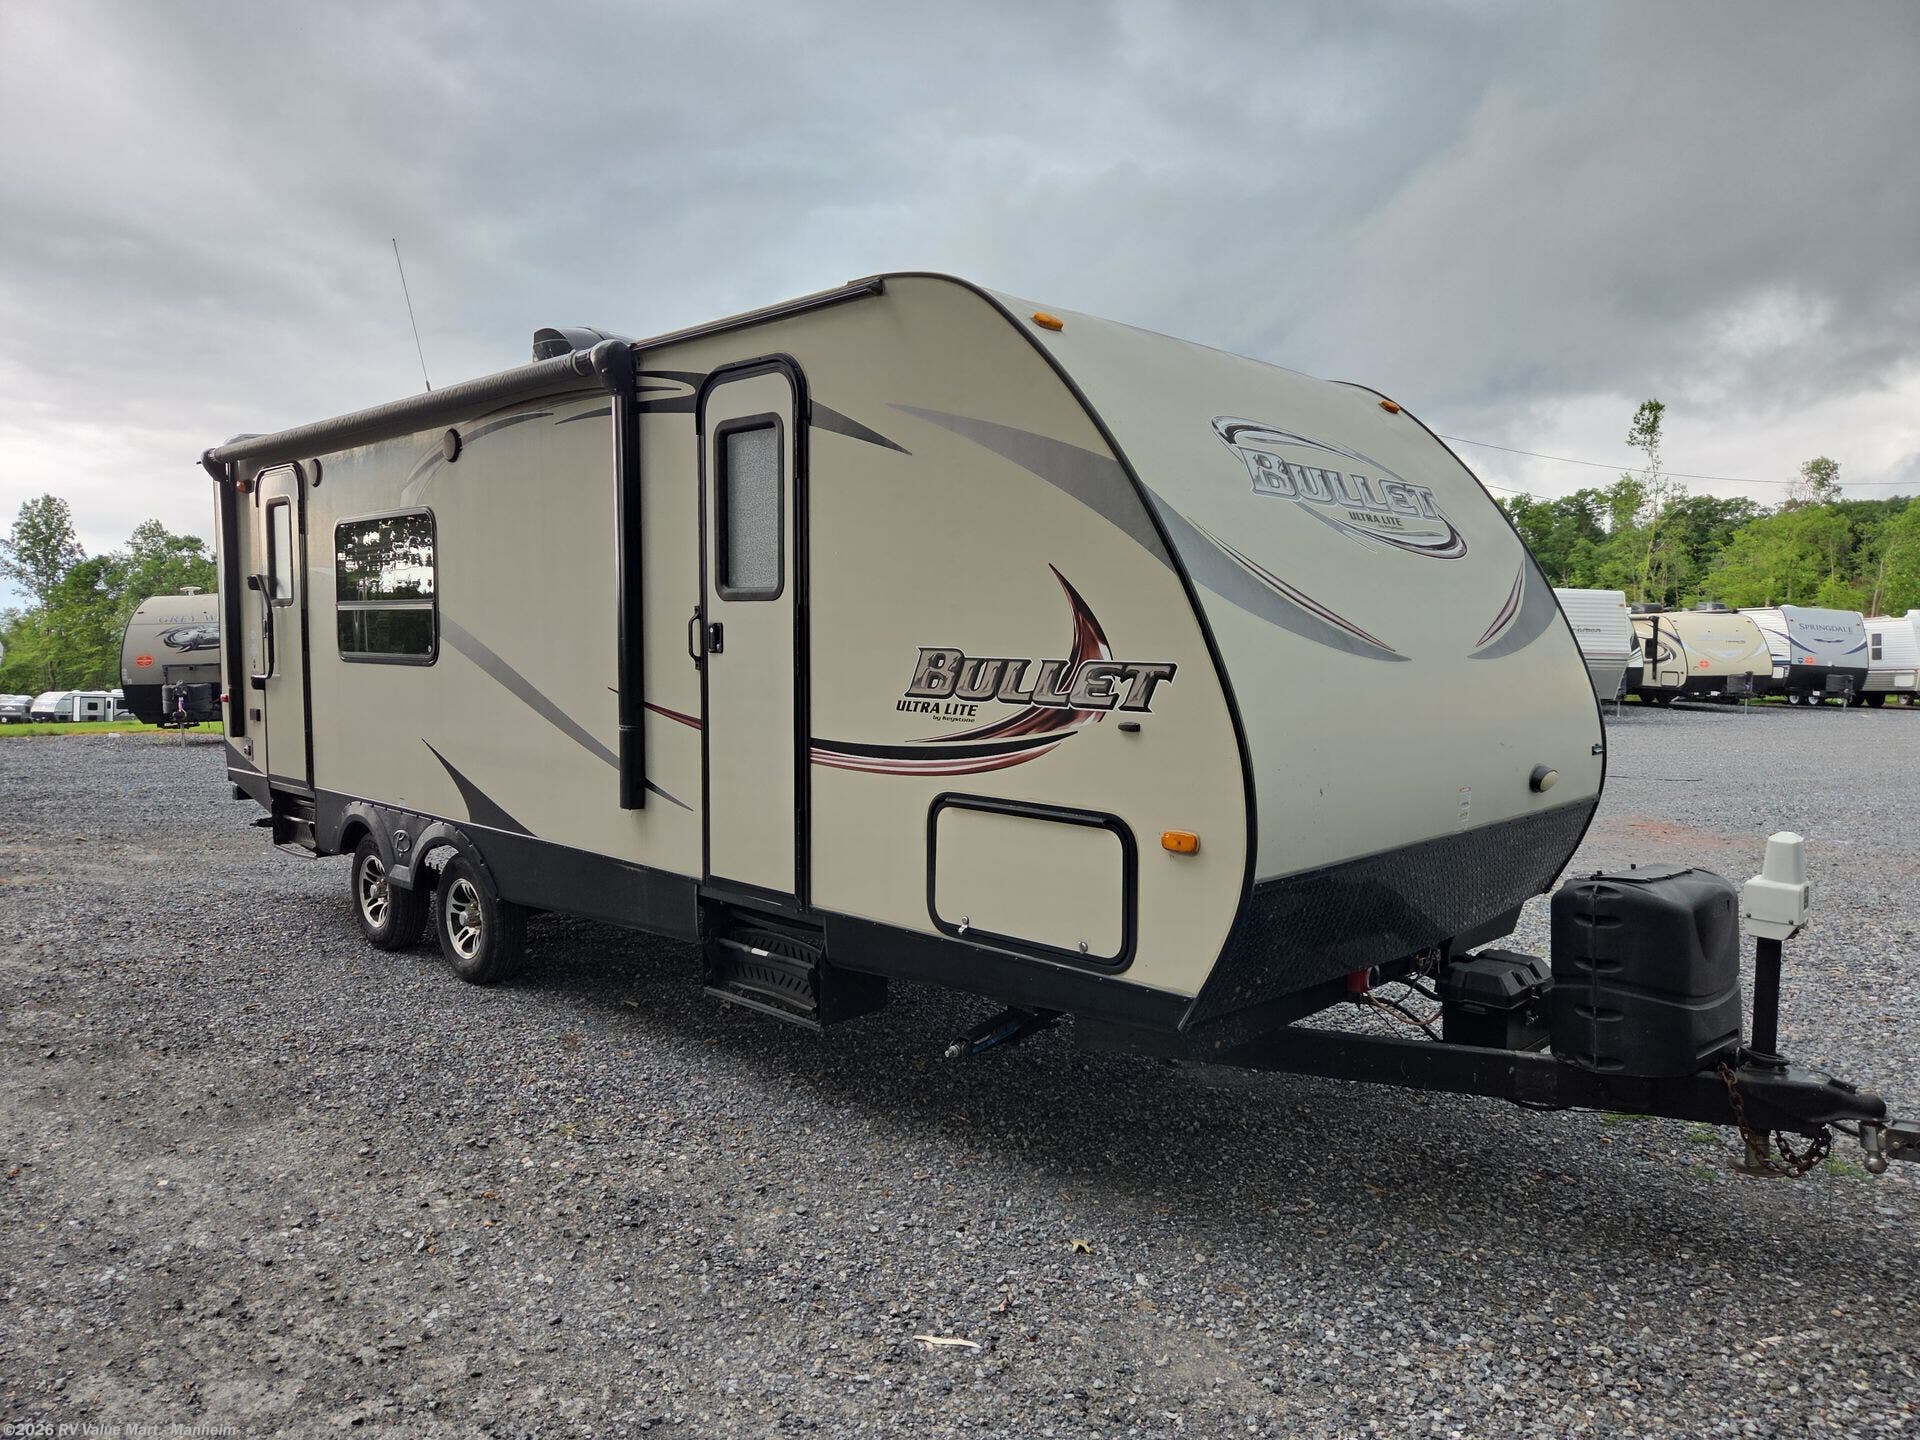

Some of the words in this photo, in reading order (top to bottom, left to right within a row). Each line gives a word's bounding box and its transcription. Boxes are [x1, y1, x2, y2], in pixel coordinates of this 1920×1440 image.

[1238, 446, 1439, 519] BULLET
[1348, 511, 1380, 523] ULTRA
[1381, 516, 1403, 526] LITE
[1798, 622, 1853, 633] SPRINGDALE
[903, 646, 1178, 713] BULLET
[896, 699, 940, 714] ULTRA
[944, 703, 979, 717] LITE
